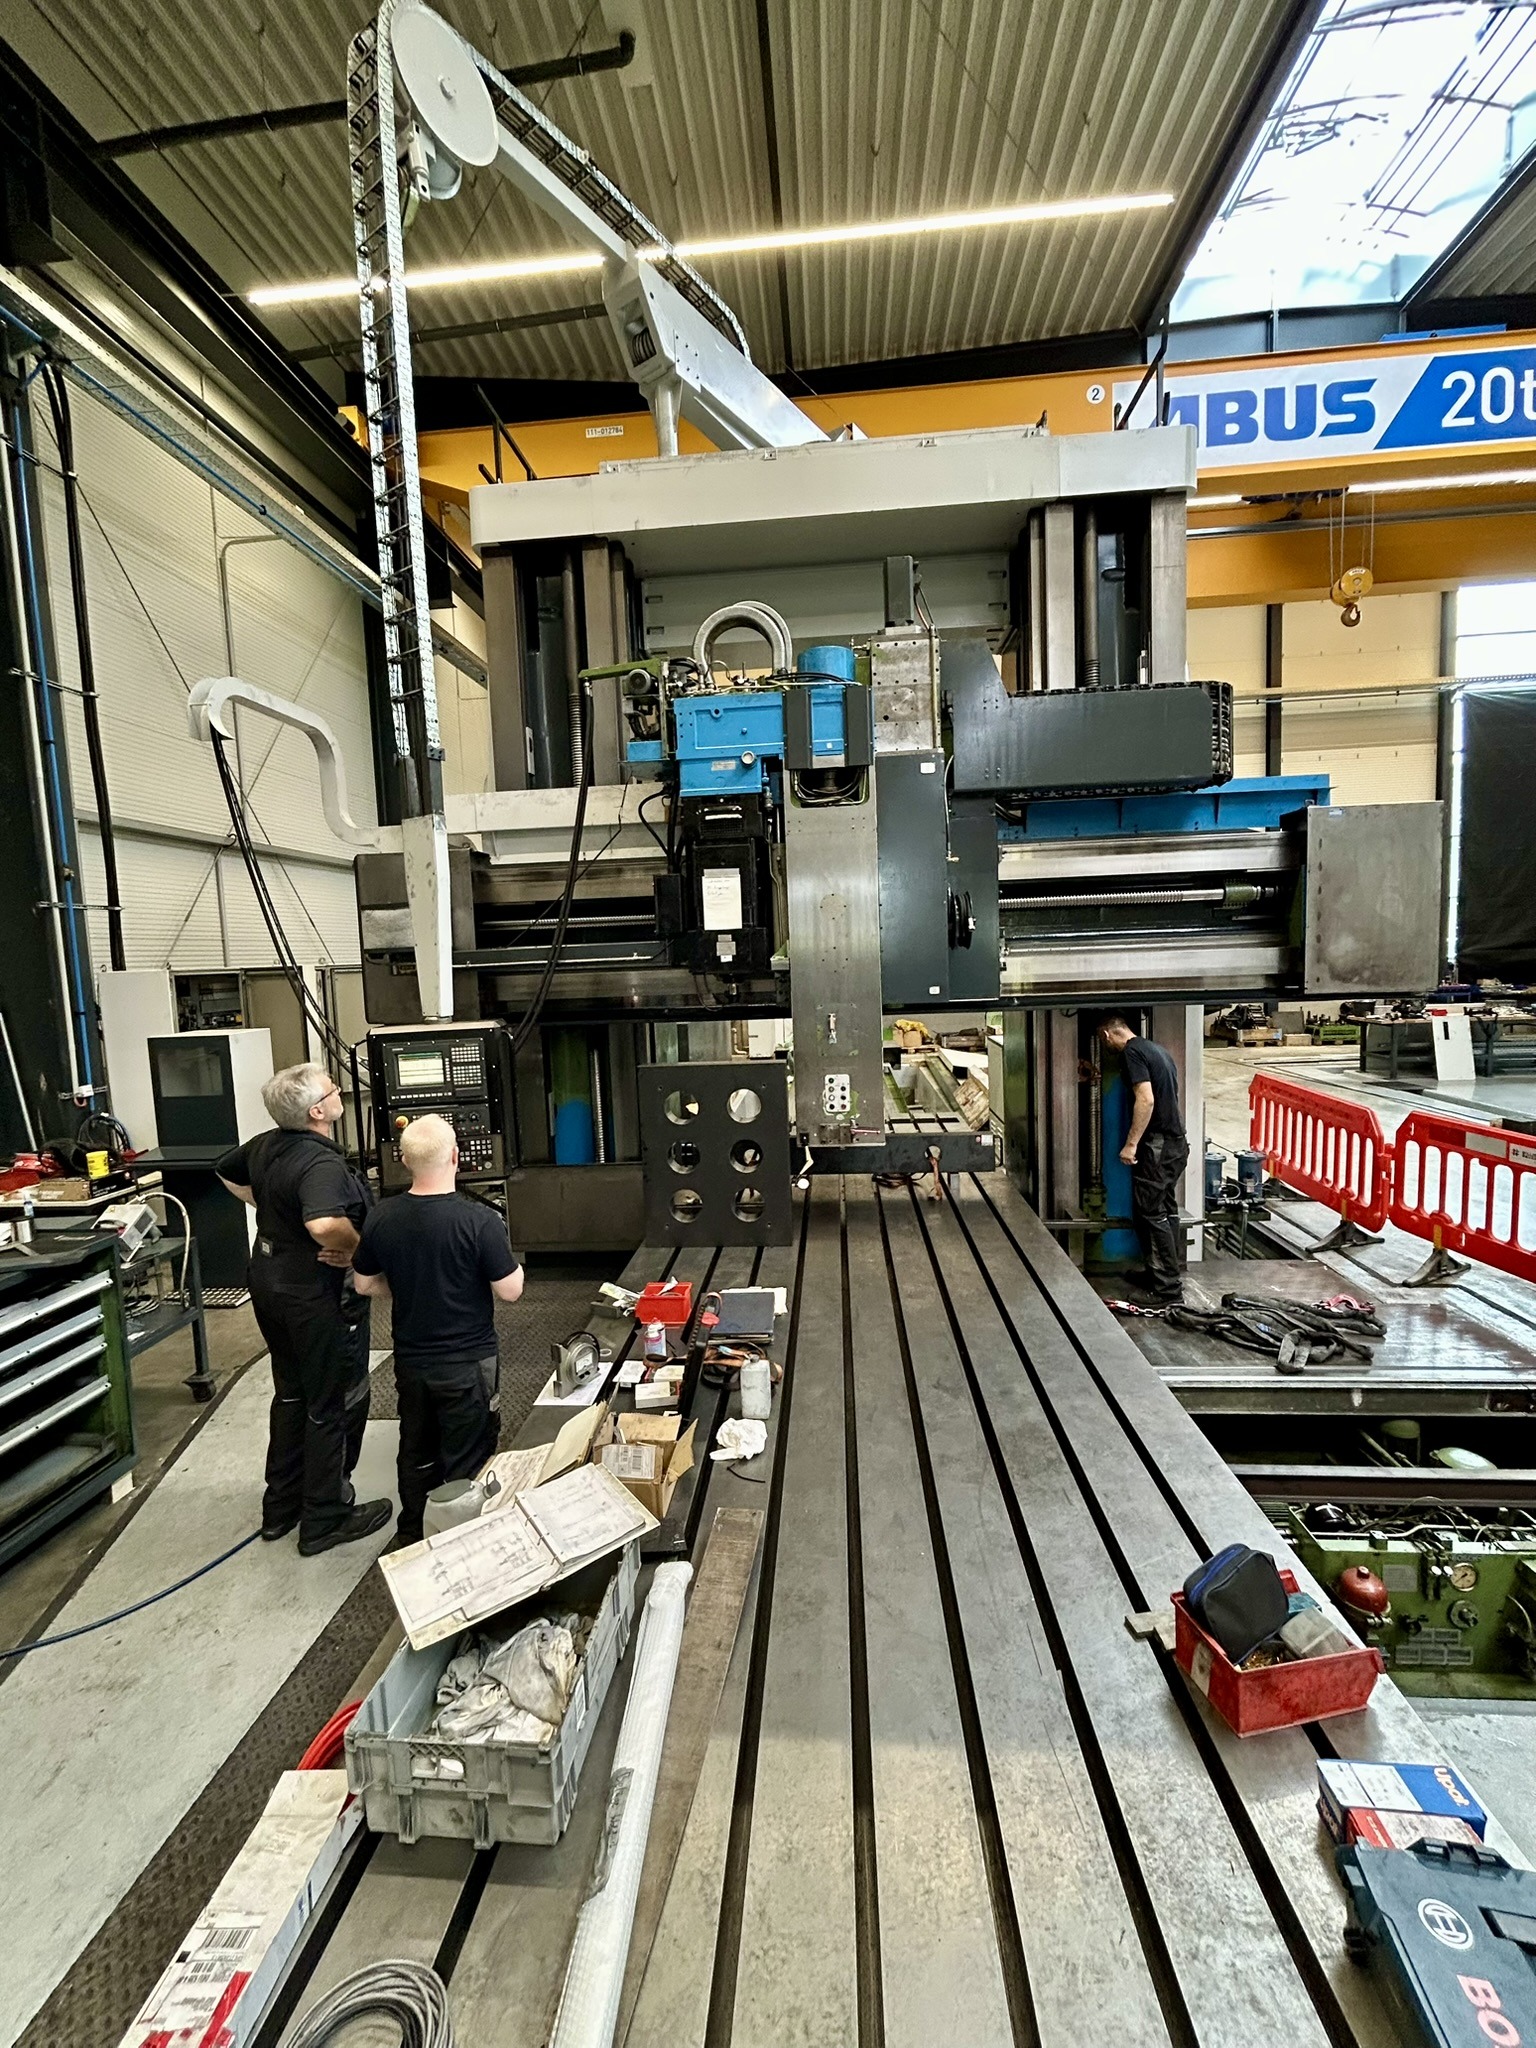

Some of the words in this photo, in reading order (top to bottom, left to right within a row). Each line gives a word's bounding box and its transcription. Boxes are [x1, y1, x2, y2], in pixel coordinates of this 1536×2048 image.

[1091, 387, 1100, 401] 2
[1441, 366, 1536, 428] 20t
[1456, 1974, 1520, 2048] BO
